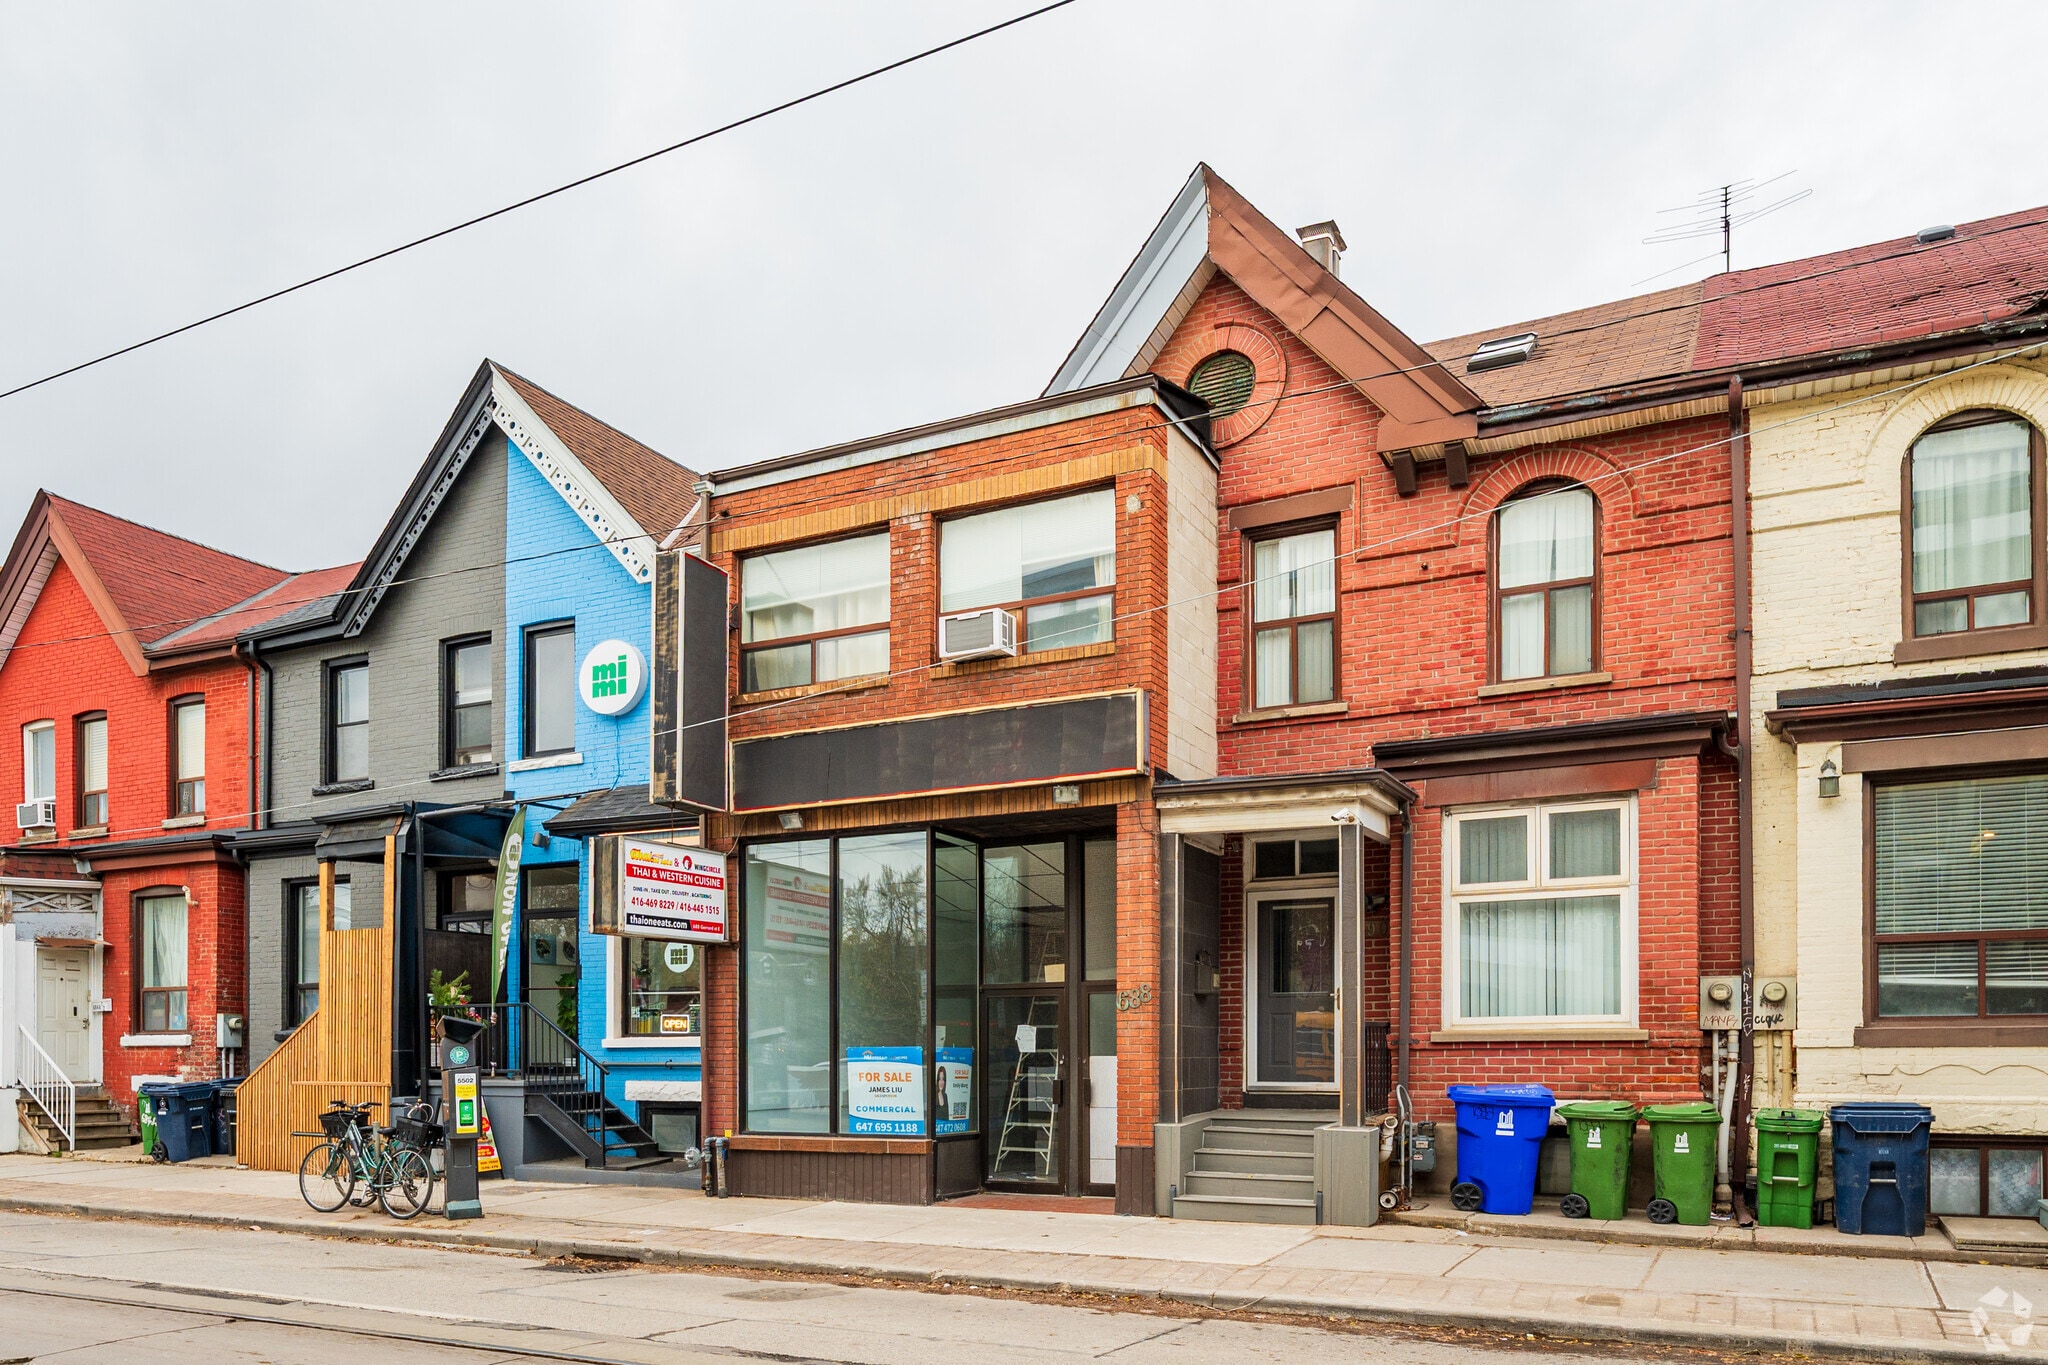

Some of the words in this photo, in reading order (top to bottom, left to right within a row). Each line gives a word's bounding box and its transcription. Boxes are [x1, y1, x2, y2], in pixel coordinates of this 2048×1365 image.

[592, 654, 627, 681] mi
[592, 678, 627, 698] mi
[674, 858, 679, 868] &
[632, 866, 651, 877] THAI
[651, 869, 658, 878] &
[659, 870, 693, 884] WESTERN
[694, 875, 721, 887] CUISINE
[502, 872, 518, 915] NOW
[631, 896, 658, 908] 416-469
[659, 899, 675, 910] 8229
[679, 902, 704, 914] 416-445
[705, 905, 720, 915] 1515
[630, 913, 688, 929] thaioneeats.com
[1116, 983, 1152, 1011] 688
[663, 1018, 687, 1029] OPEN
[858, 1072, 881, 1082] FOR
[883, 1071, 912, 1082] SALE
[856, 1105, 916, 1113] COMMERCIAL
[856, 1122, 873, 1132] 647
[875, 1122, 892, 1132] 695
[894, 1123, 918, 1133] 1188
